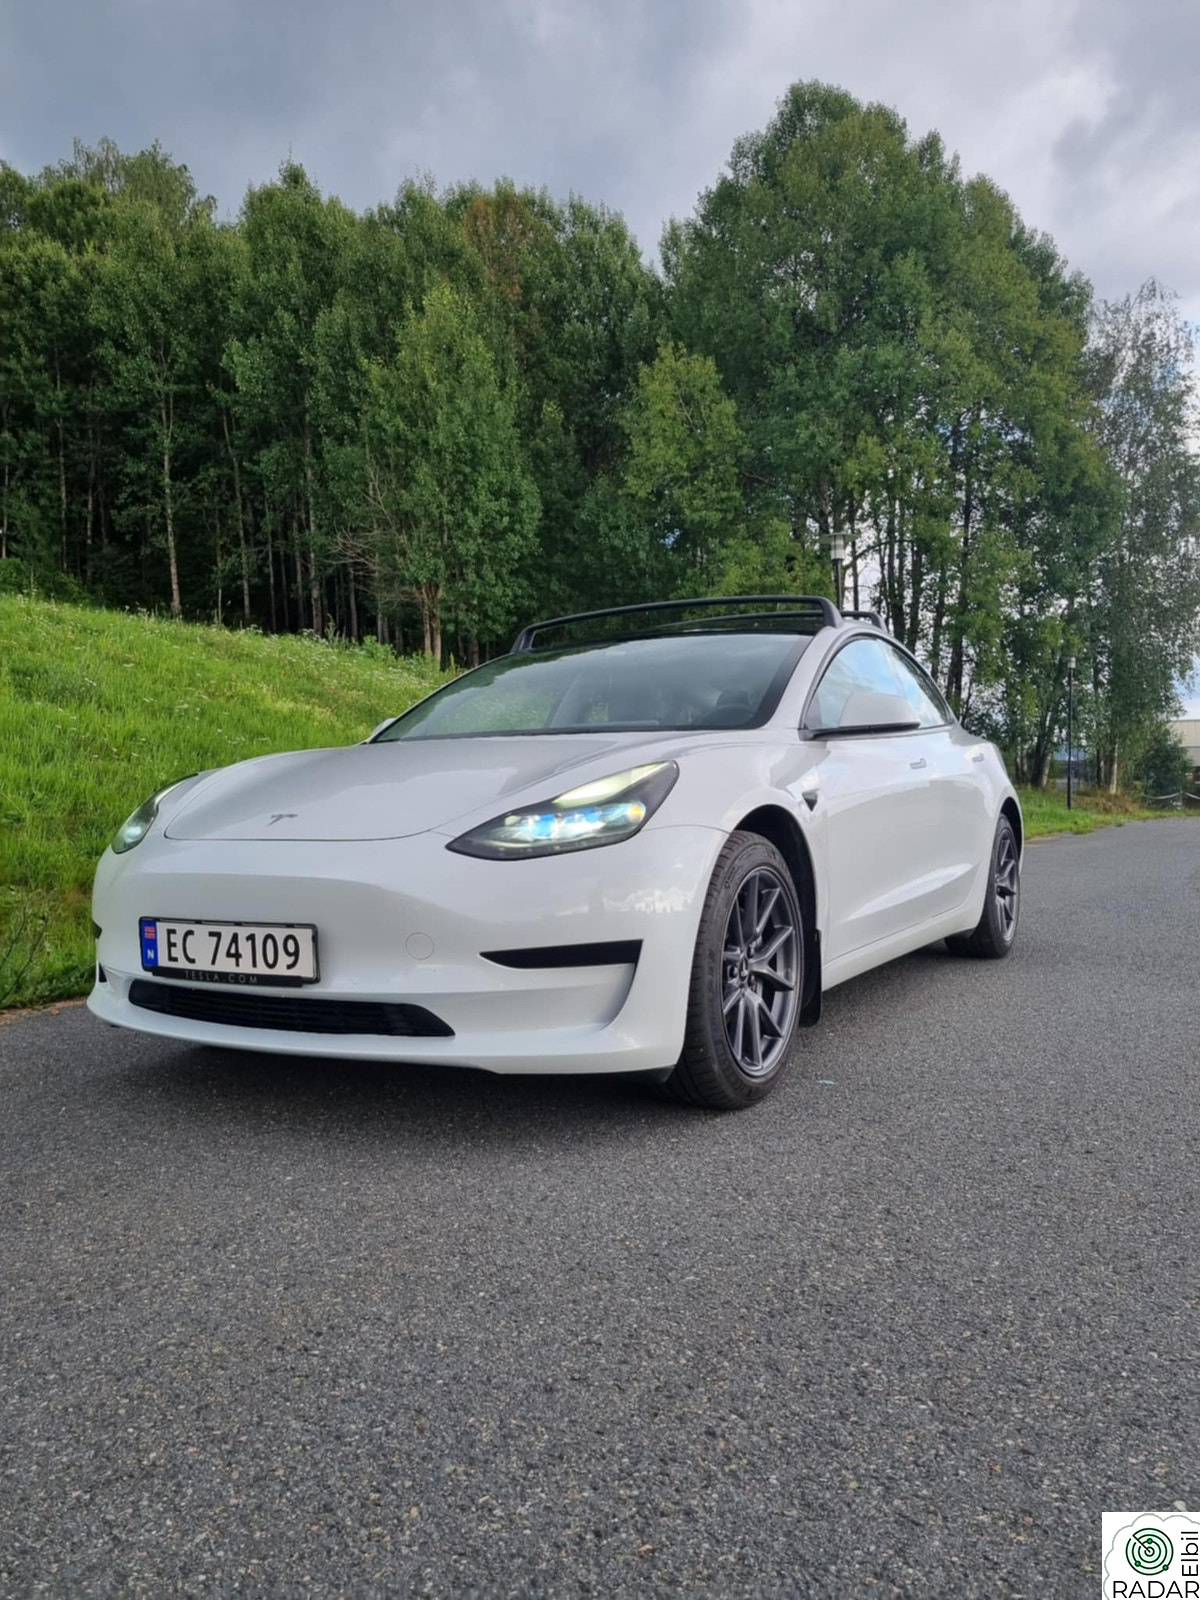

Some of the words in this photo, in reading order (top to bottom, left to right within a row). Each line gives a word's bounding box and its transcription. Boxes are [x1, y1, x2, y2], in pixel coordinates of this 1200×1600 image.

[147, 949, 155, 960] N
[166, 928, 196, 964] EC
[208, 931, 300, 970] 74109
[184, 970, 258, 984] TESLA.COM
